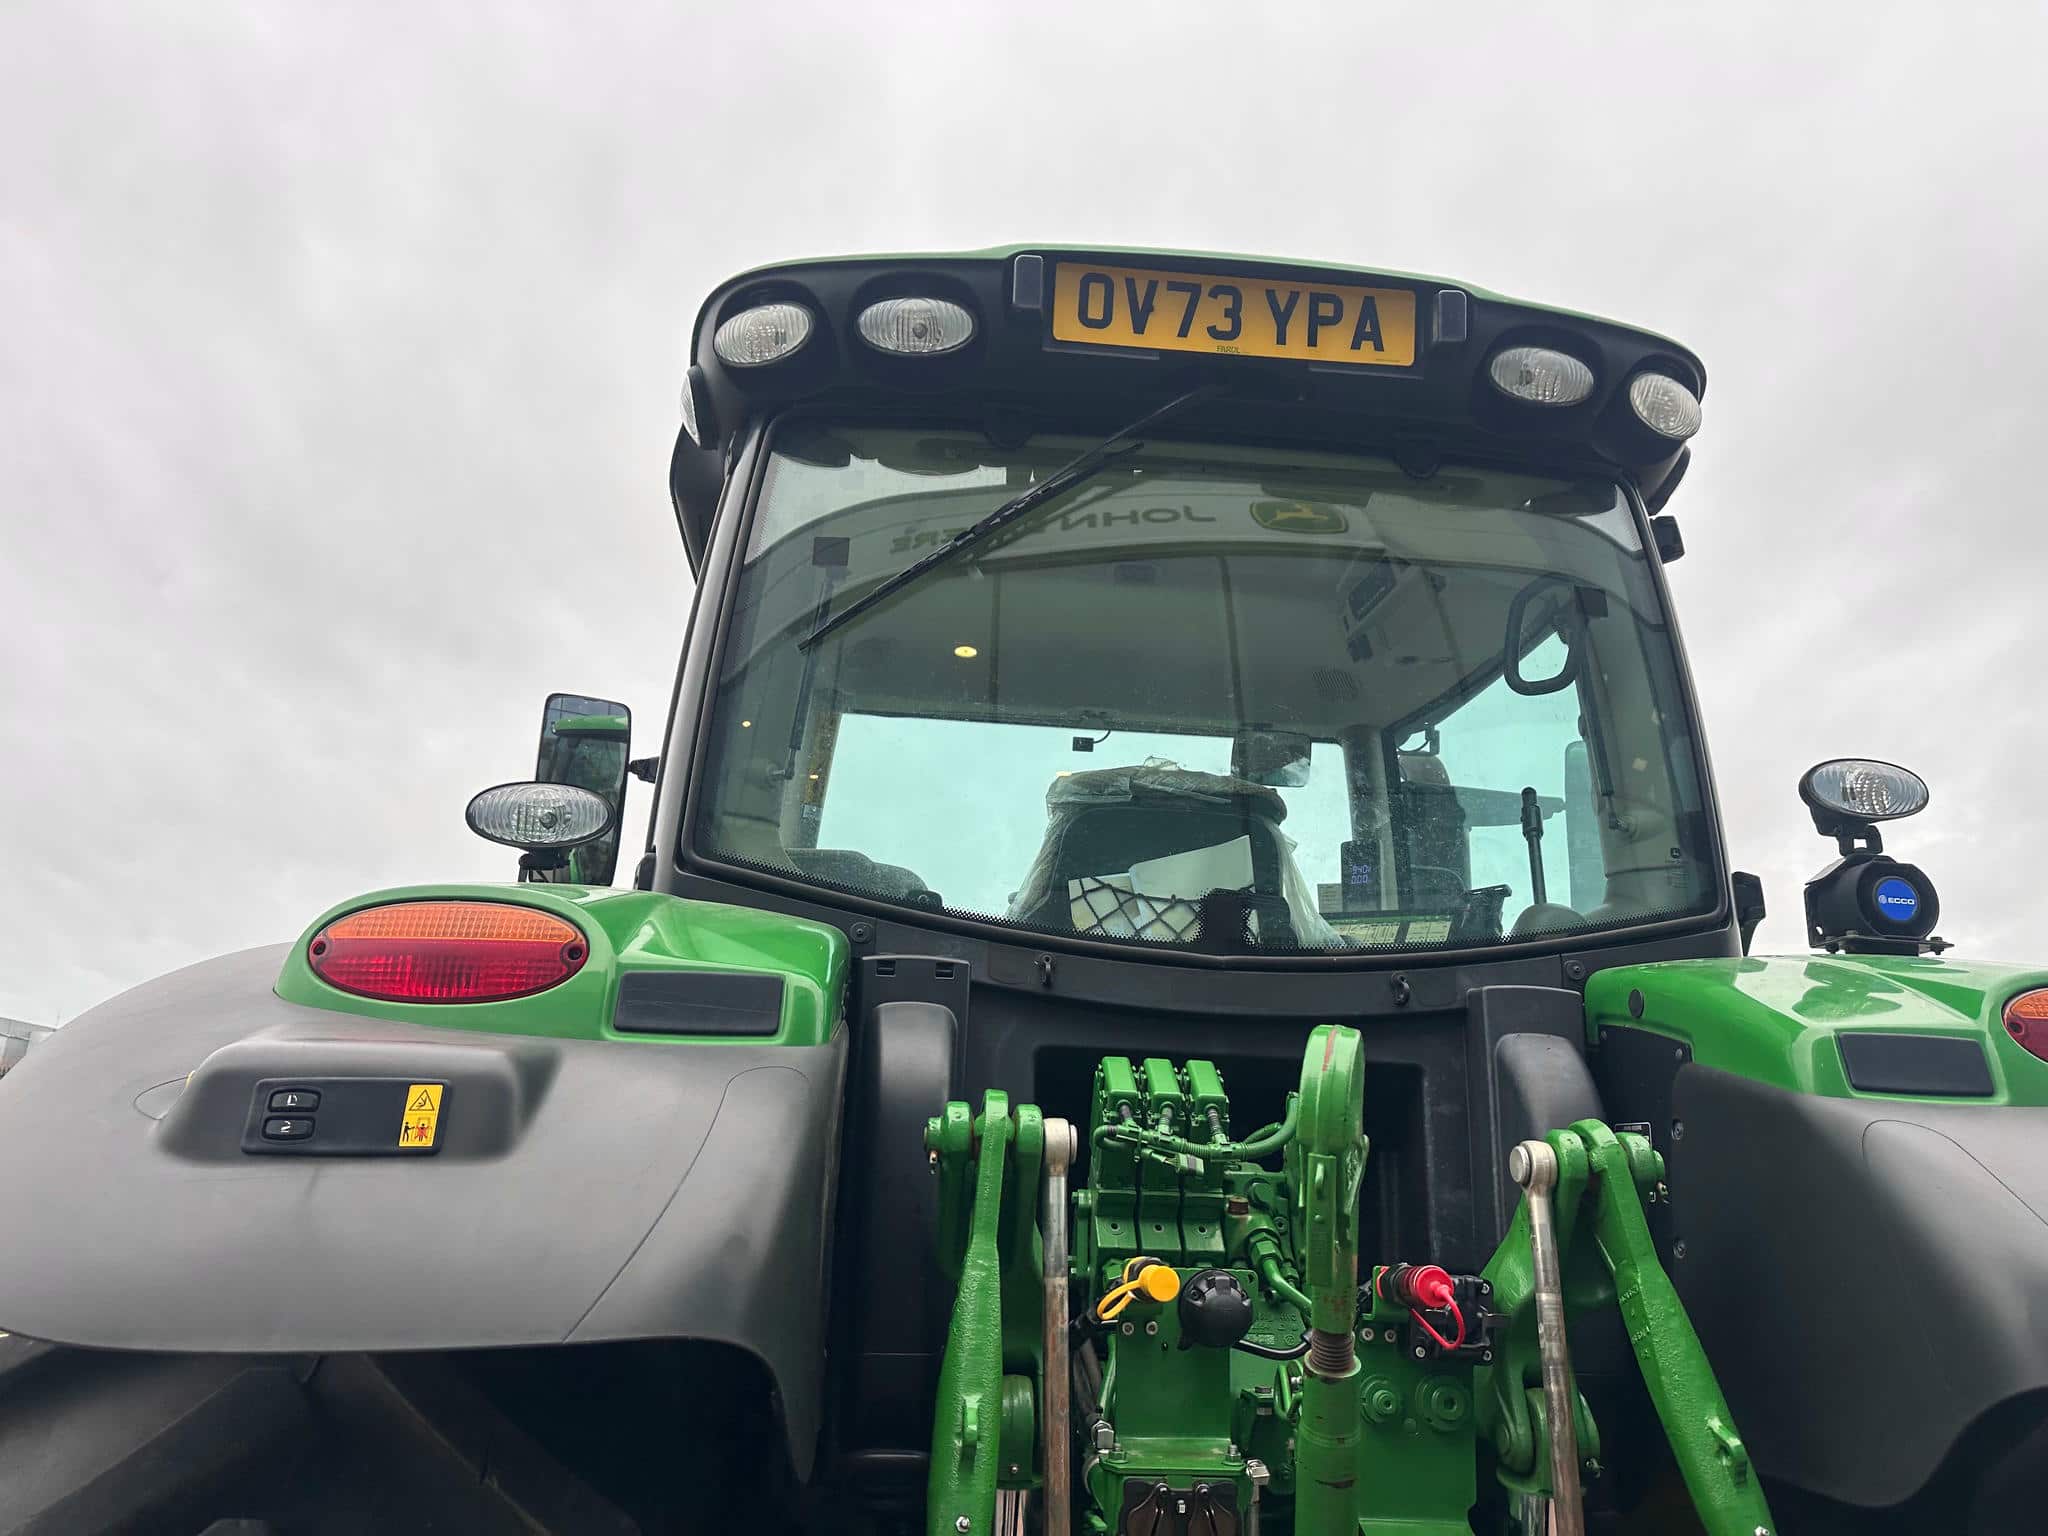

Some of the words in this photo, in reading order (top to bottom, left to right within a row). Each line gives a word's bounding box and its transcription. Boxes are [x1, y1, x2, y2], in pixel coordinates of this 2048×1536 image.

[1077, 272, 1243, 342] OV73
[1265, 288, 1385, 353] YPA
[1887, 897, 1914, 905] ECCO
